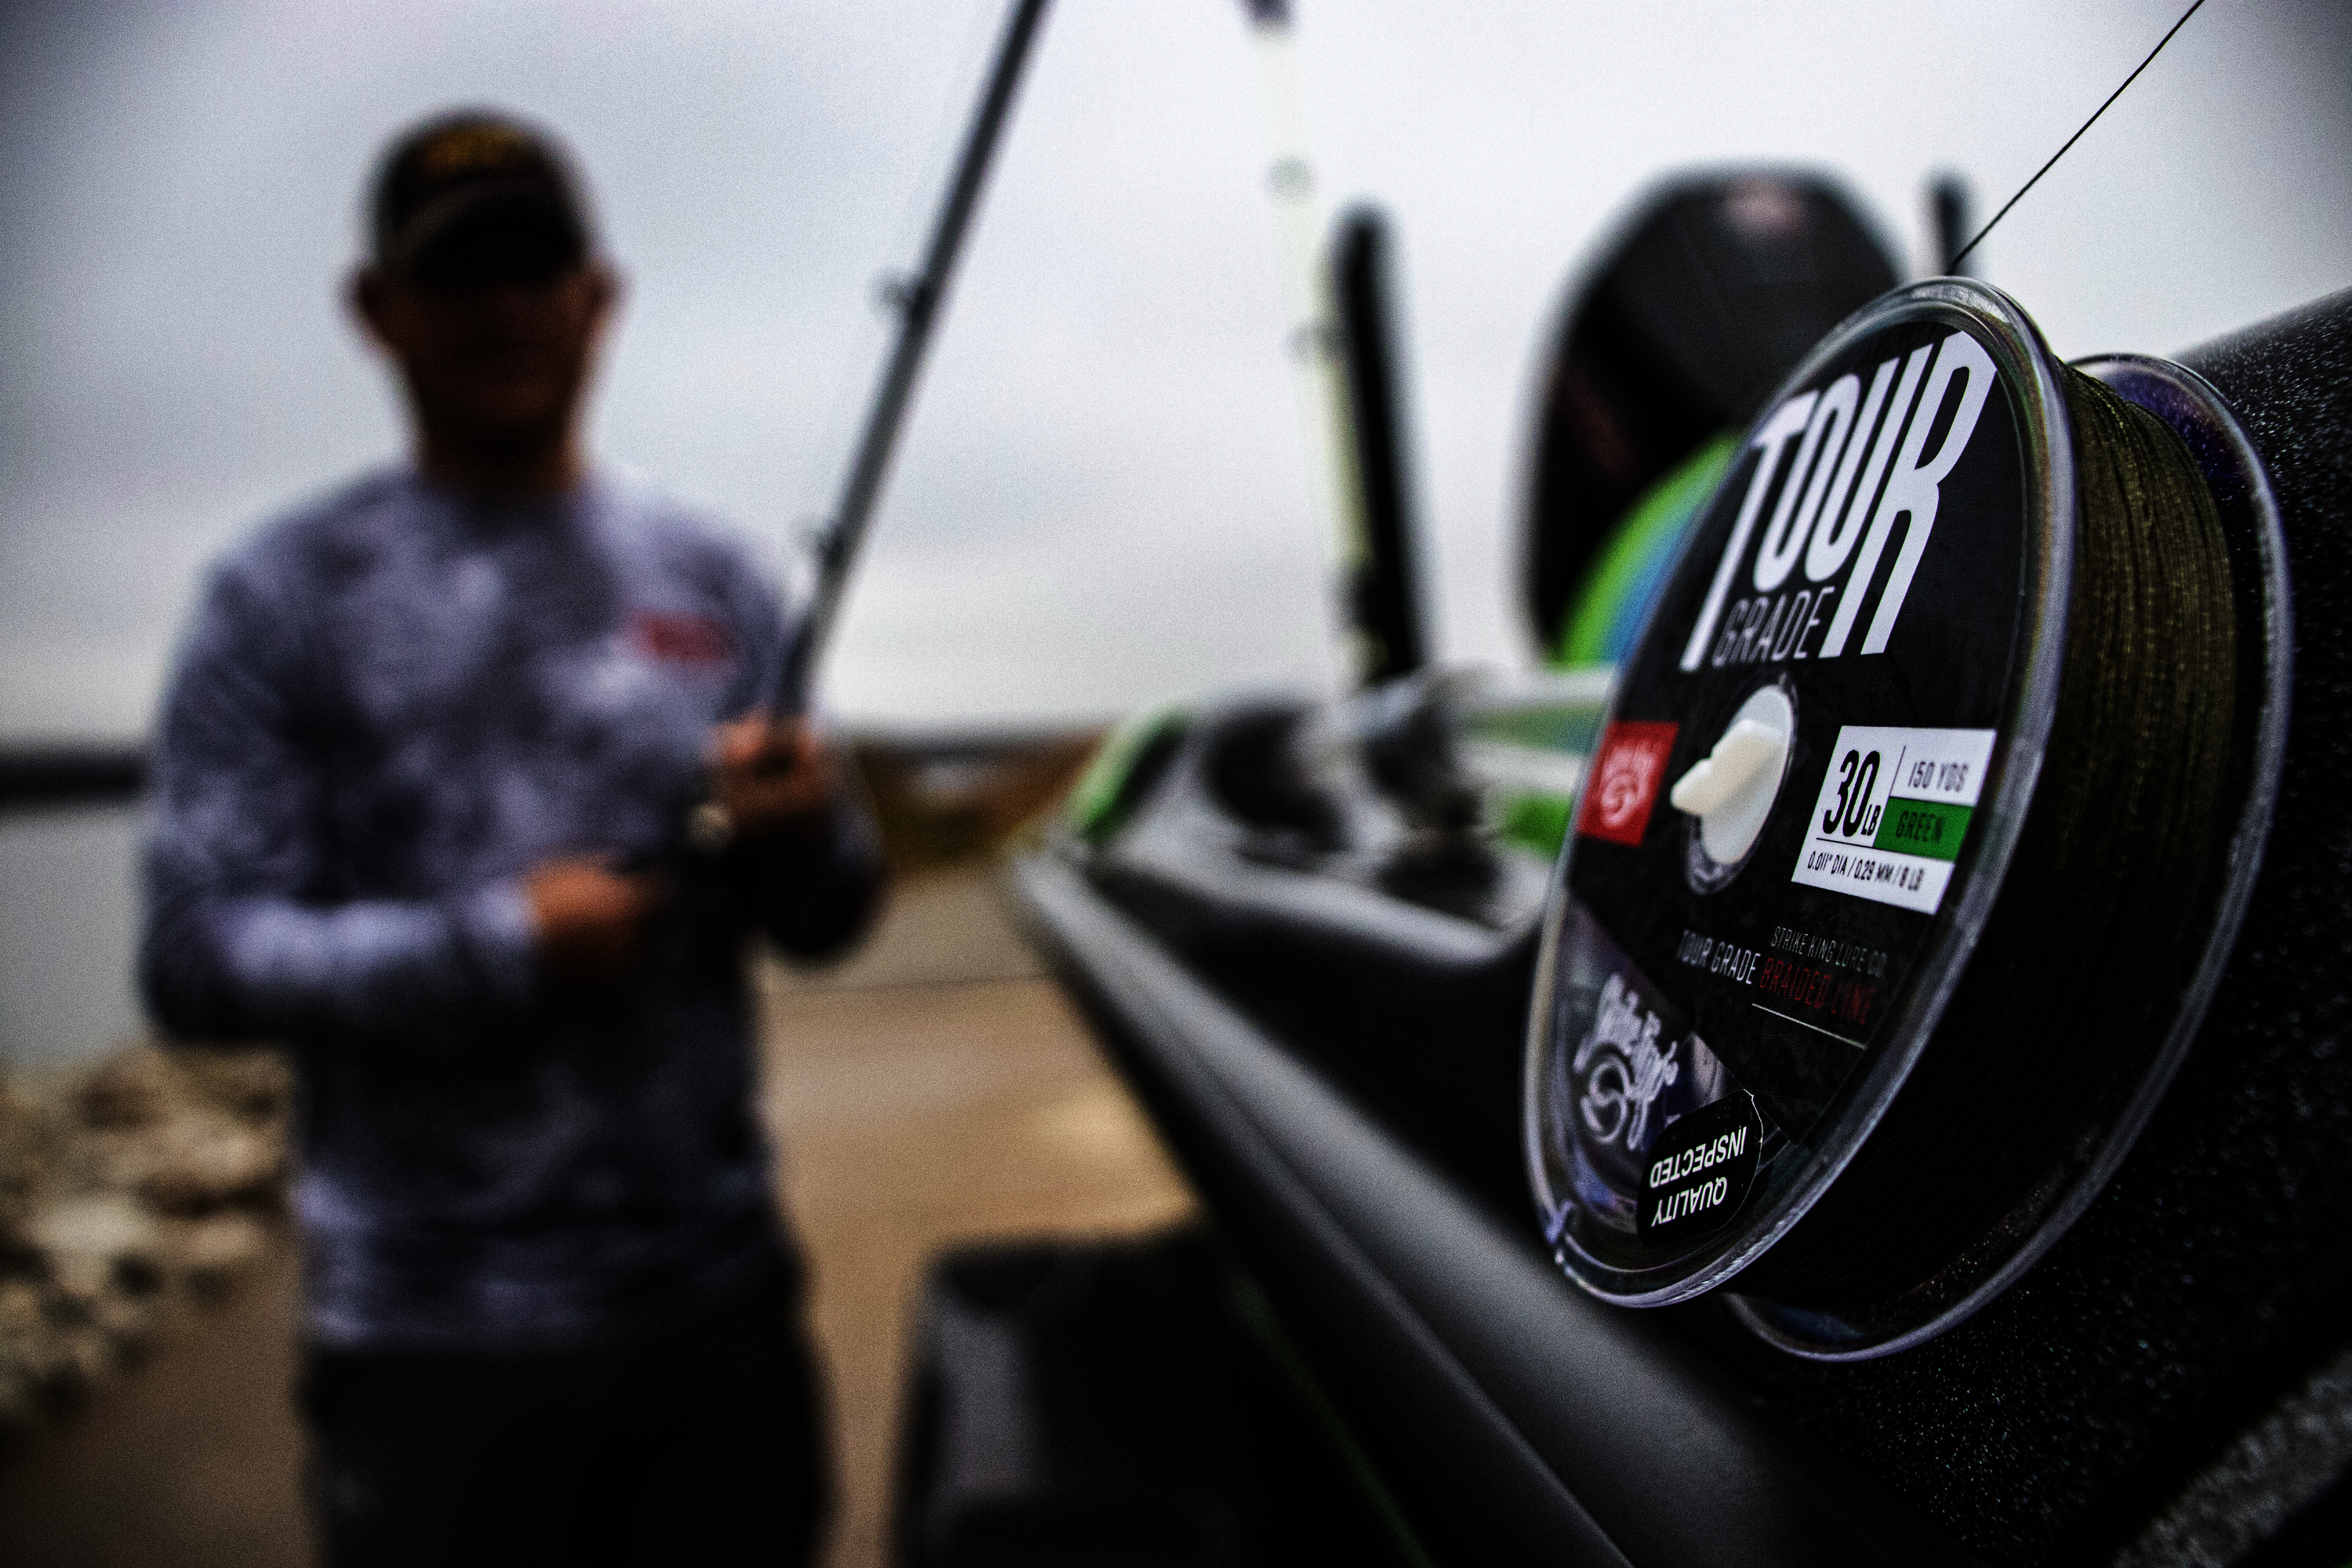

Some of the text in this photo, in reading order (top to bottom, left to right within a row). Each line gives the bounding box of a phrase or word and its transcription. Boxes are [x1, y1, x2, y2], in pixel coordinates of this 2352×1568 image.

[1680, 330, 1997, 672] TOUR
[1712, 586, 1835, 668] GRADE
[1907, 760, 1969, 793] 150 YDS
[1896, 810, 1944, 844] GREEN
[1831, 855, 1848, 876] DIA
[1853, 859, 1875, 881] 0.29
[1874, 862, 1895, 884] MM
[1770, 925, 1809, 955] STRIKE
[1807, 935, 1836, 963] KING
[1835, 942, 1868, 972] LURE
[1675, 928, 1877, 1025] TOUR GRADE BRAIDED LINE
[1650, 1126, 1748, 1189] INSPECTED
[1651, 1177, 1727, 1227] QUALITY
